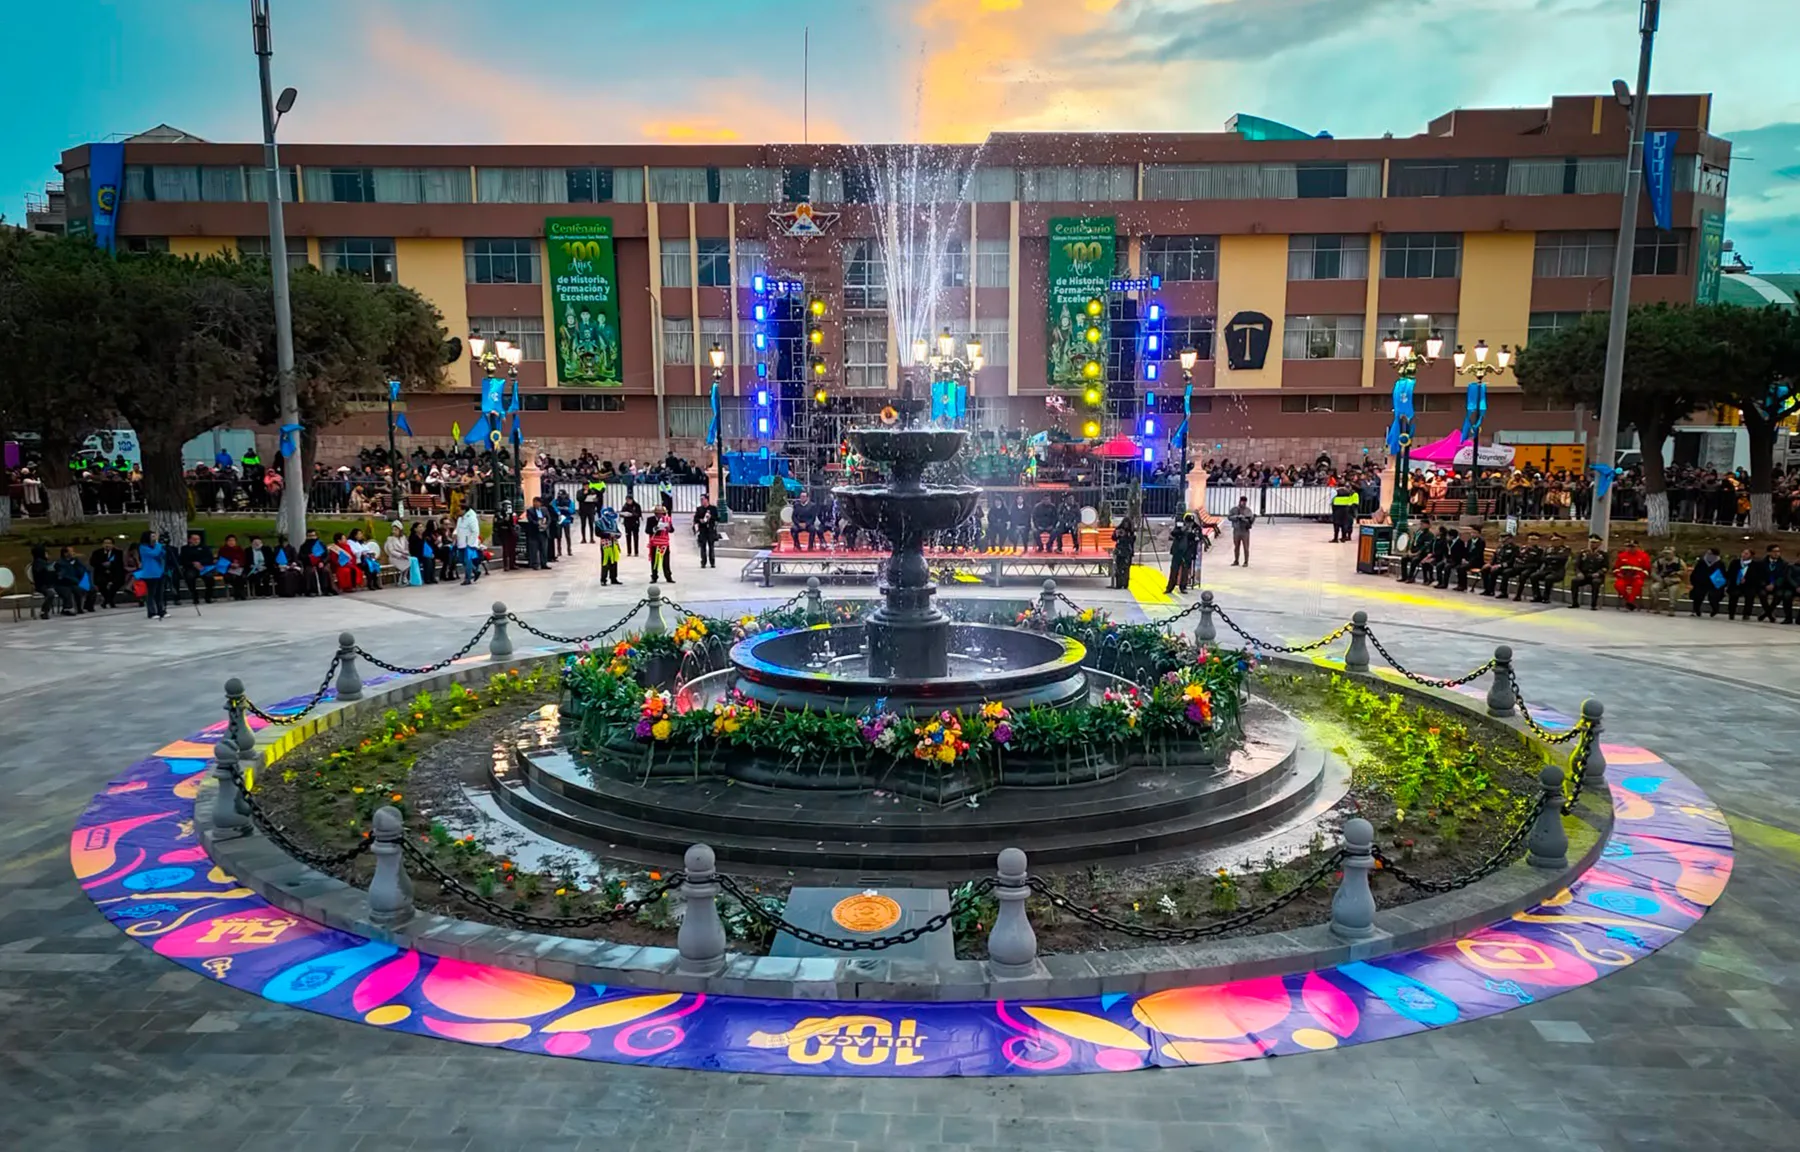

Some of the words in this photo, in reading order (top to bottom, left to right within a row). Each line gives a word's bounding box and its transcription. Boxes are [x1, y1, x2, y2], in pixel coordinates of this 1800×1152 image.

[561, 241, 600, 261] 100
[1063, 242, 1102, 261] 100
[557, 275, 569, 284] de
[1056, 277, 1067, 286] de
[556, 283, 603, 293] Formación
[604, 285, 611, 294] y
[560, 293, 609, 302] Excelencia
[788, 1015, 926, 1066] 100
[816, 1034, 929, 1048] JULIACA
